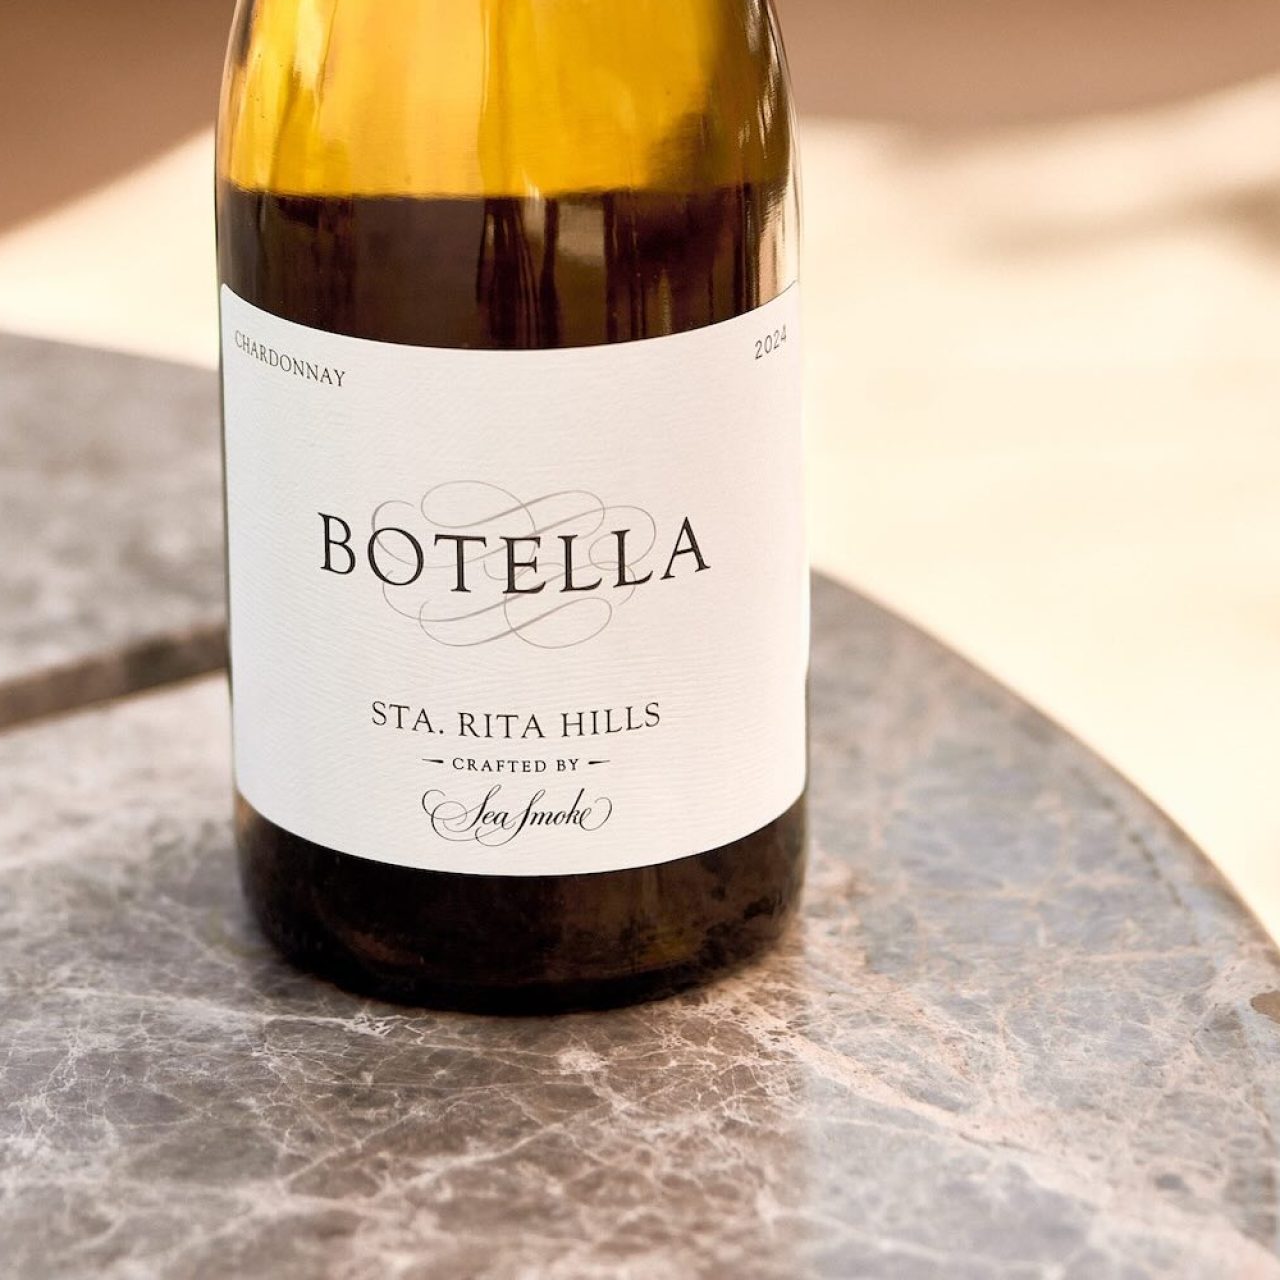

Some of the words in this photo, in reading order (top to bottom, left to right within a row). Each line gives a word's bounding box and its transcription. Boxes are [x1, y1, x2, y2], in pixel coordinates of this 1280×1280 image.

[234, 330, 346, 388] CHARDONNAY
[754, 323, 787, 361] 2024
[317, 511, 712, 595] BOTELLA
[371, 700, 444, 734] STA.
[457, 711, 546, 739] RITA
[560, 701, 660, 738] HILLS
[452, 756, 547, 773] CRAFTED
[556, 758, 580, 772] BY
[422, 784, 516, 841] Sea
[487, 787, 613, 846] Smoke
